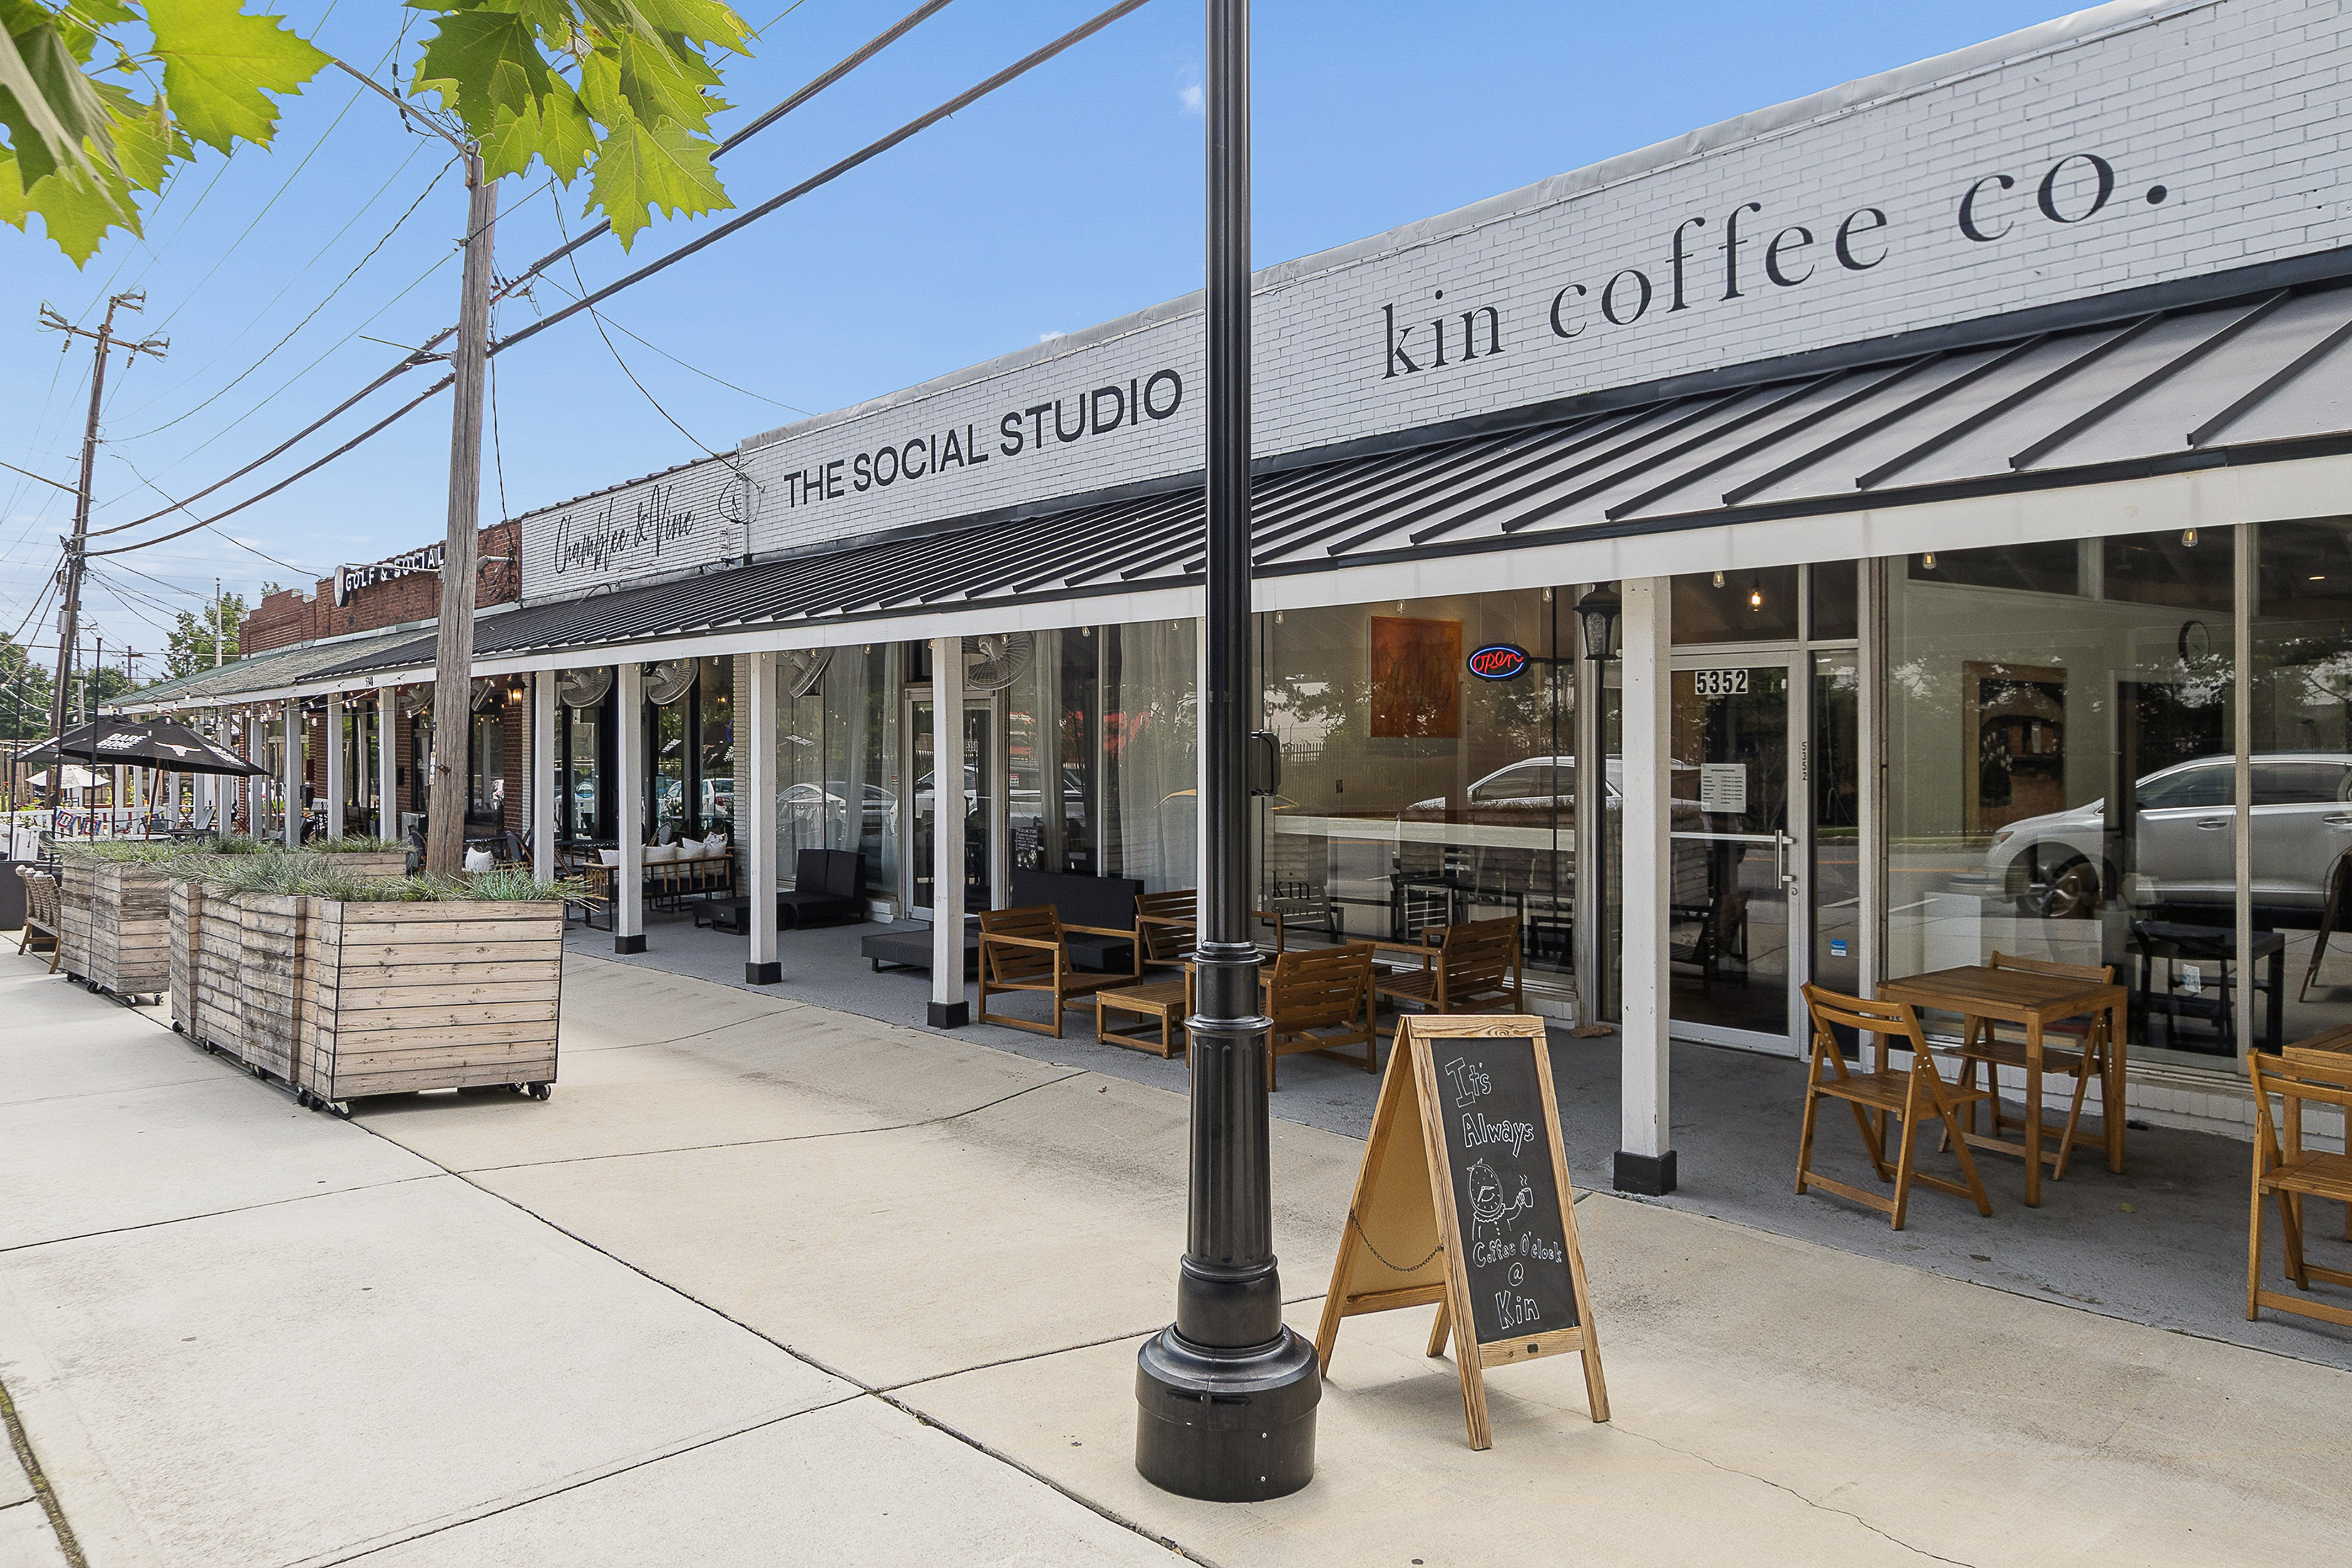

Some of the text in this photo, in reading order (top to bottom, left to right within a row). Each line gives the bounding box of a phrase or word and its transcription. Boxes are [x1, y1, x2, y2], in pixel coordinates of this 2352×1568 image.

[1380, 153, 2168, 380] kin coffee co.
[783, 368, 1183, 508] THE SOCIAL STUDIO
[649, 484, 697, 557] Vine
[345, 545, 445, 592] GOLF & SOCIAL
[1696, 670, 1746, 693] 5352
[1272, 870, 1311, 900] kin
[1445, 1056, 1492, 1108] It's
[1462, 1113, 1535, 1158] Always
[1472, 1238, 1516, 1268] Coffee
[1507, 1262, 1524, 1286] @
[1495, 1290, 1540, 1330] Kin
